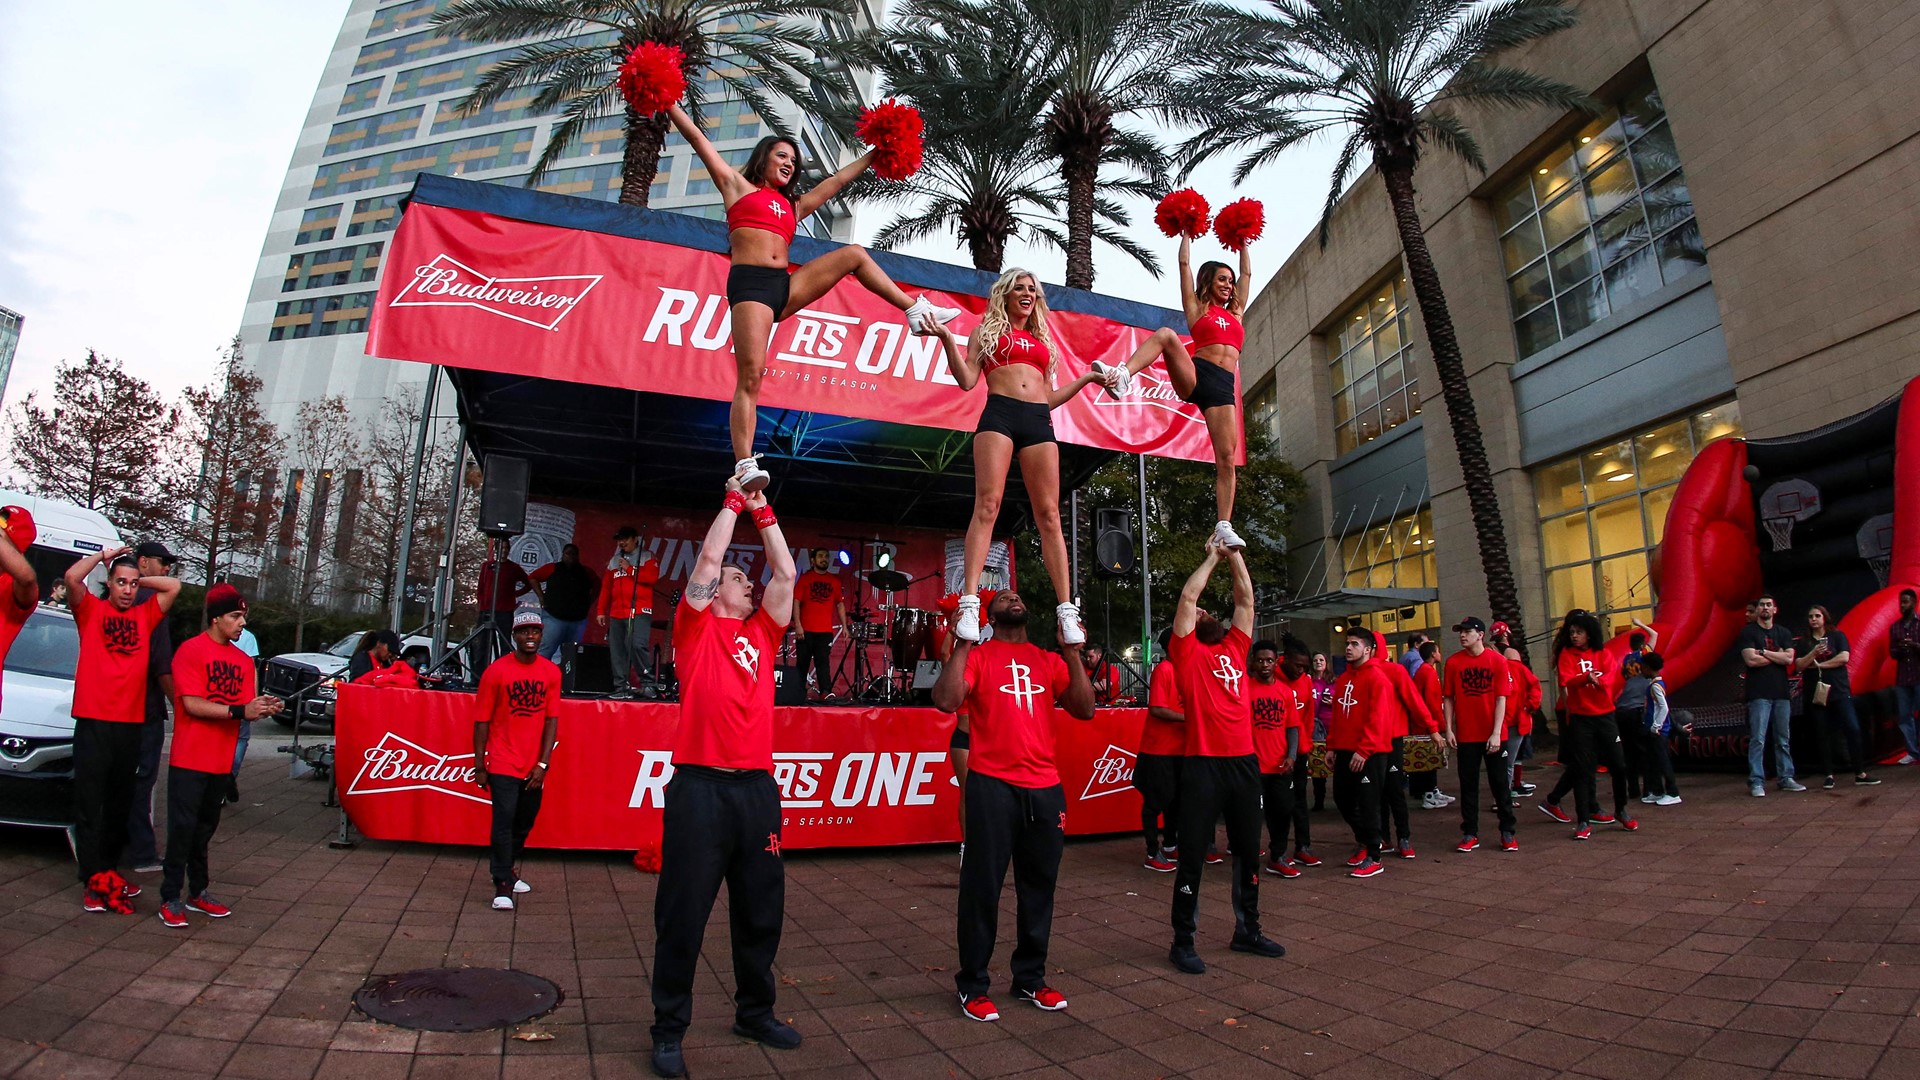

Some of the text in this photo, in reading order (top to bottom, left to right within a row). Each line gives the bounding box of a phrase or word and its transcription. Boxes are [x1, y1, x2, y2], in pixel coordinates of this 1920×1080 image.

[414, 265, 576, 309] Budweiser
[642, 286, 779, 354] RU
[788, 317, 848, 358] AS
[763, 367, 878, 391] 017'18 SEASON
[364, 747, 477, 783] Budwe
[830, 752, 947, 808] ONE
[799, 816, 854, 826] SEASON
